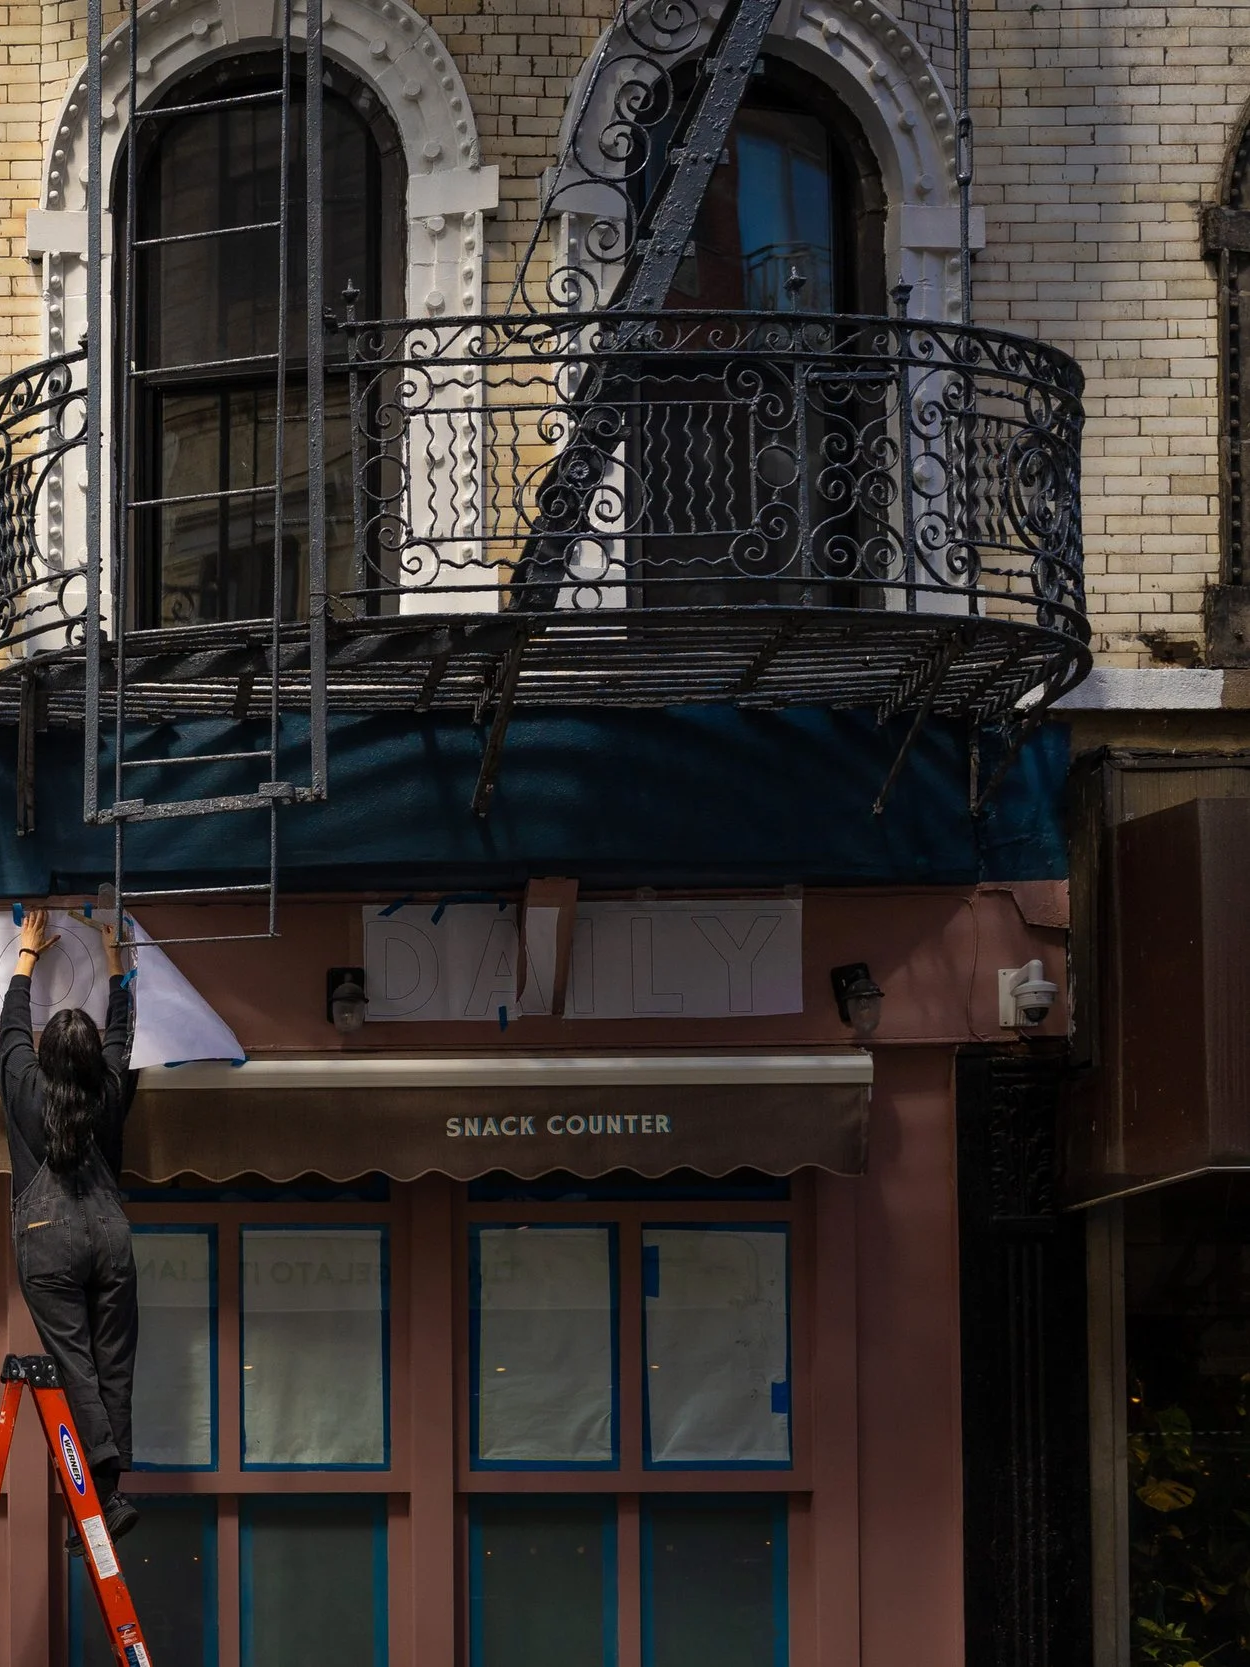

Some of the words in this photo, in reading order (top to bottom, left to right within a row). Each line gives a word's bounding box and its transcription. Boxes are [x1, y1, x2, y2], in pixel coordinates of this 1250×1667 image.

[366, 916, 782, 1016] DAILY
[446, 1115, 536, 1137] SNACK
[546, 1114, 671, 1135] COUNTER
[63, 1439, 82, 1481] WERNER
